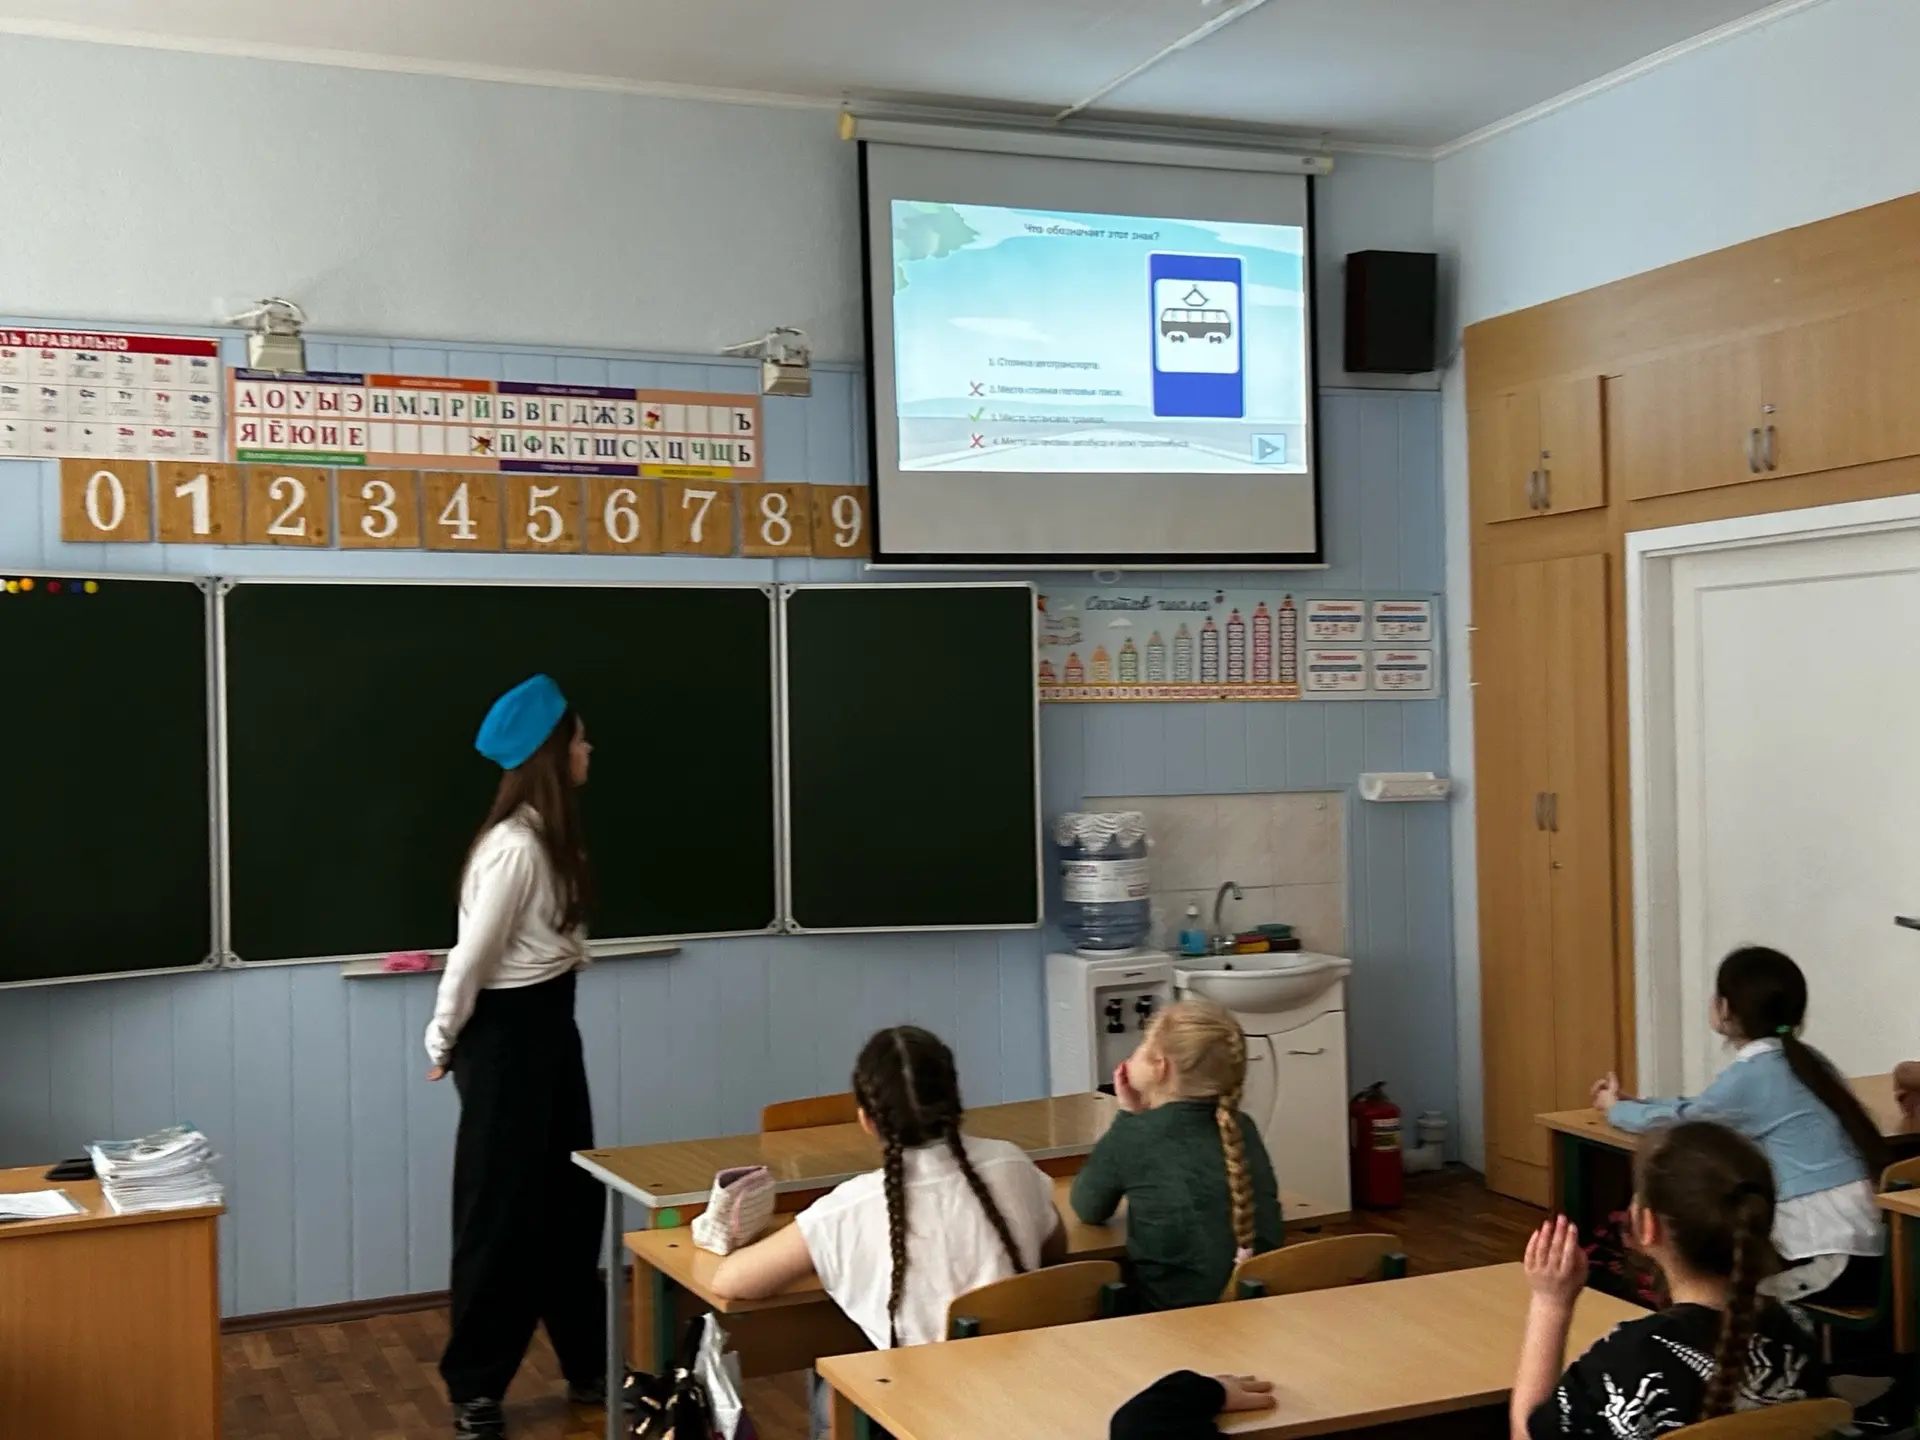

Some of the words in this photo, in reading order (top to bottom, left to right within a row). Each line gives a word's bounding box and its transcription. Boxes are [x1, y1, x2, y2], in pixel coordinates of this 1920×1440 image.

[1023, 223, 1043, 234] Что
[1046, 224, 1105, 238] обозначает
[1108, 230, 1129, 239] этот
[1131, 231, 1160, 241] знак?
[25, 332, 129, 350] ПРАВИЛЬНО
[85, 470, 126, 532] 0
[175, 473, 212, 535] 1
[266, 476, 307, 537] 2
[360, 480, 398, 539] 3
[438, 482, 478, 540] 4
[526, 485, 564, 543] 5
[603, 488, 640, 544] 6
[682, 488, 718, 543] 7
[760, 492, 792, 546] 8
[831, 495, 863, 548] 9
